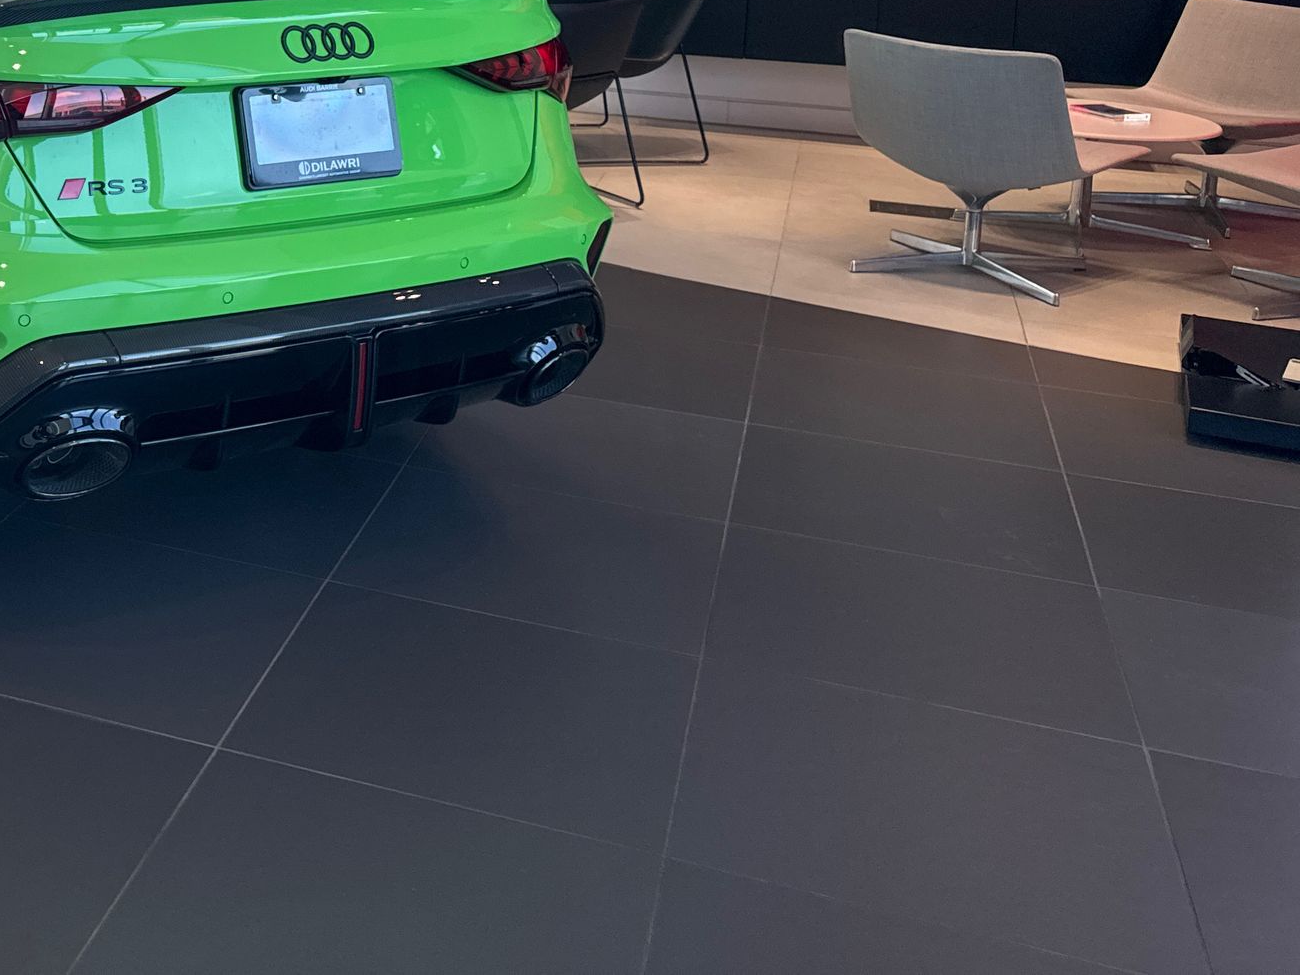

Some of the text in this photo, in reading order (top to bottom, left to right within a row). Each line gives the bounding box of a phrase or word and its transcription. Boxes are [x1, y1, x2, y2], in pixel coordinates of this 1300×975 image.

[311, 157, 360, 172] DILAWRI
[88, 178, 148, 196] RS 3
